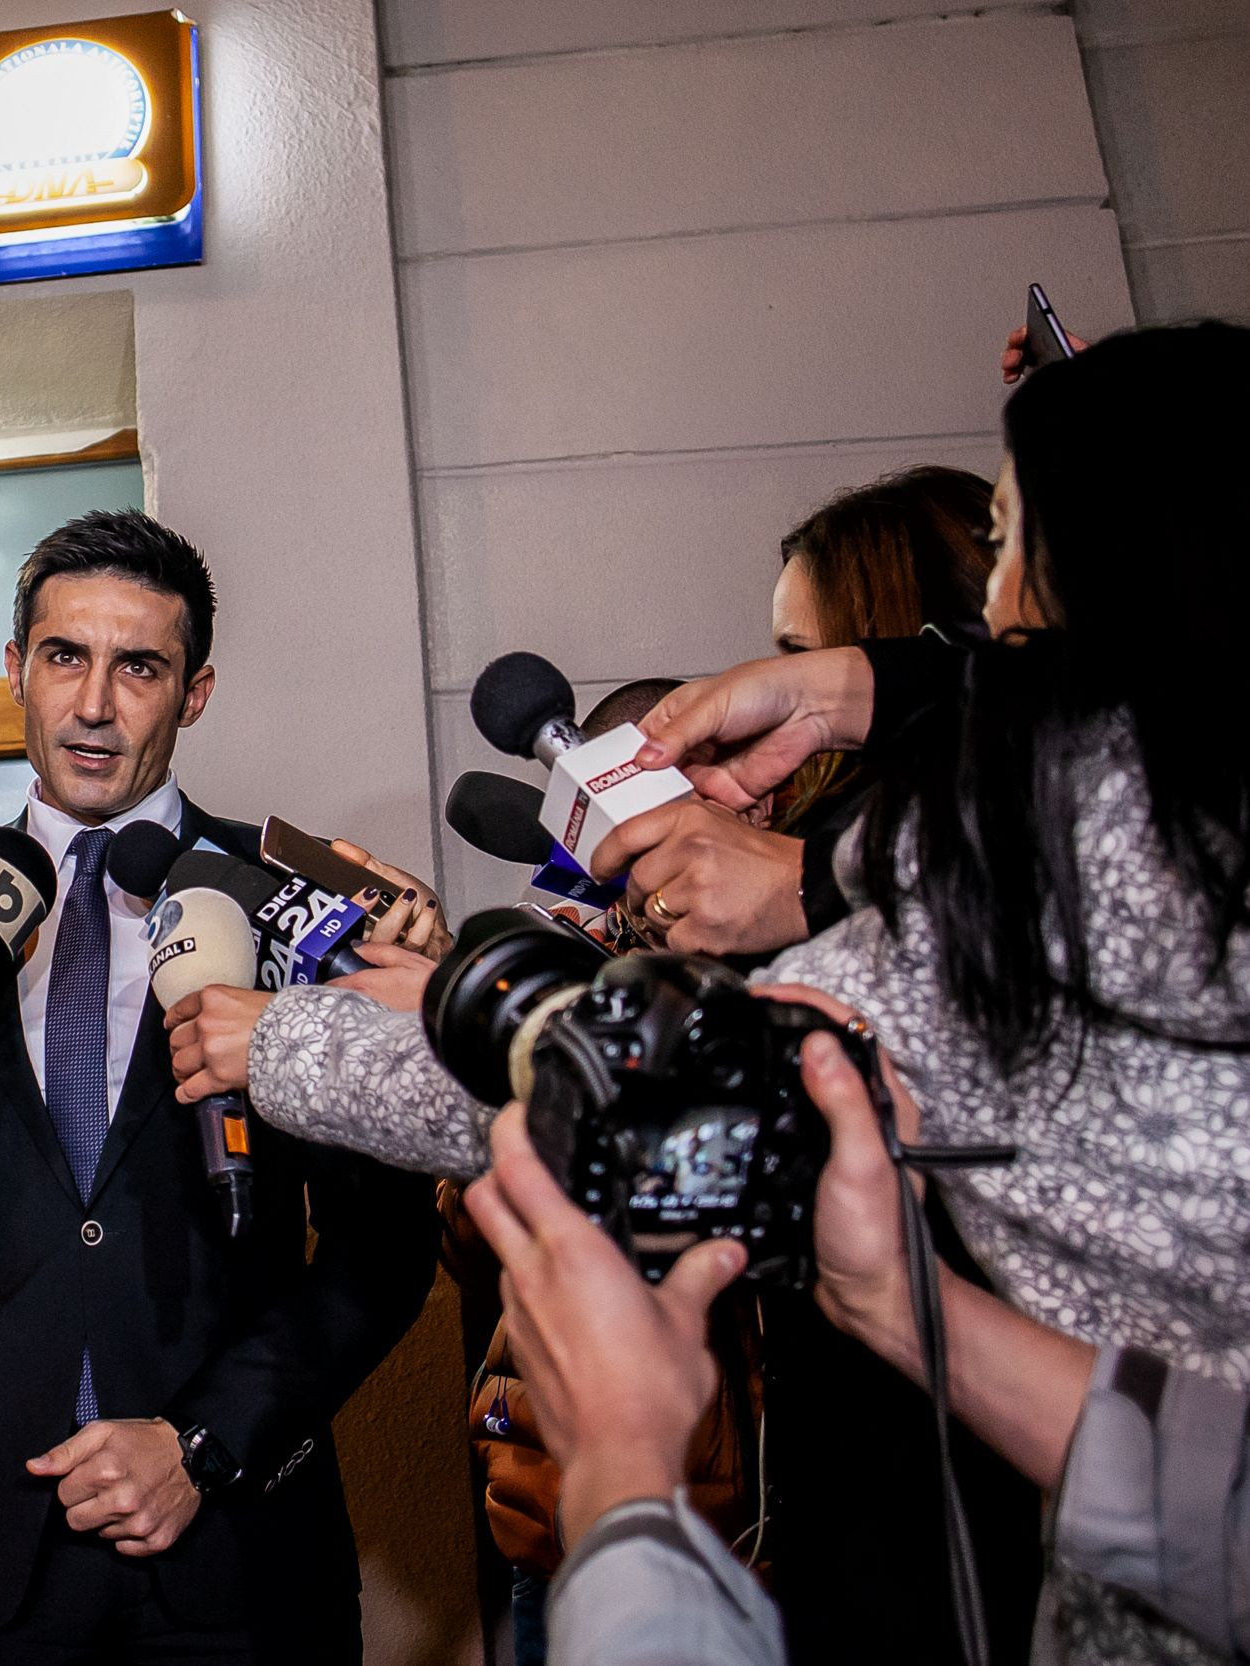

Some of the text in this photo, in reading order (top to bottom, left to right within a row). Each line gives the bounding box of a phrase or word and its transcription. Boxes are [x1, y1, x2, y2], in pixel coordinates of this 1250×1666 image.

[256, 877, 307, 922] DIGI
[277, 888, 349, 946] 24
[319, 918, 342, 938] HD
[183, 939, 194, 951] D
[261, 938, 303, 990] 24
[296, 972, 308, 985] D
